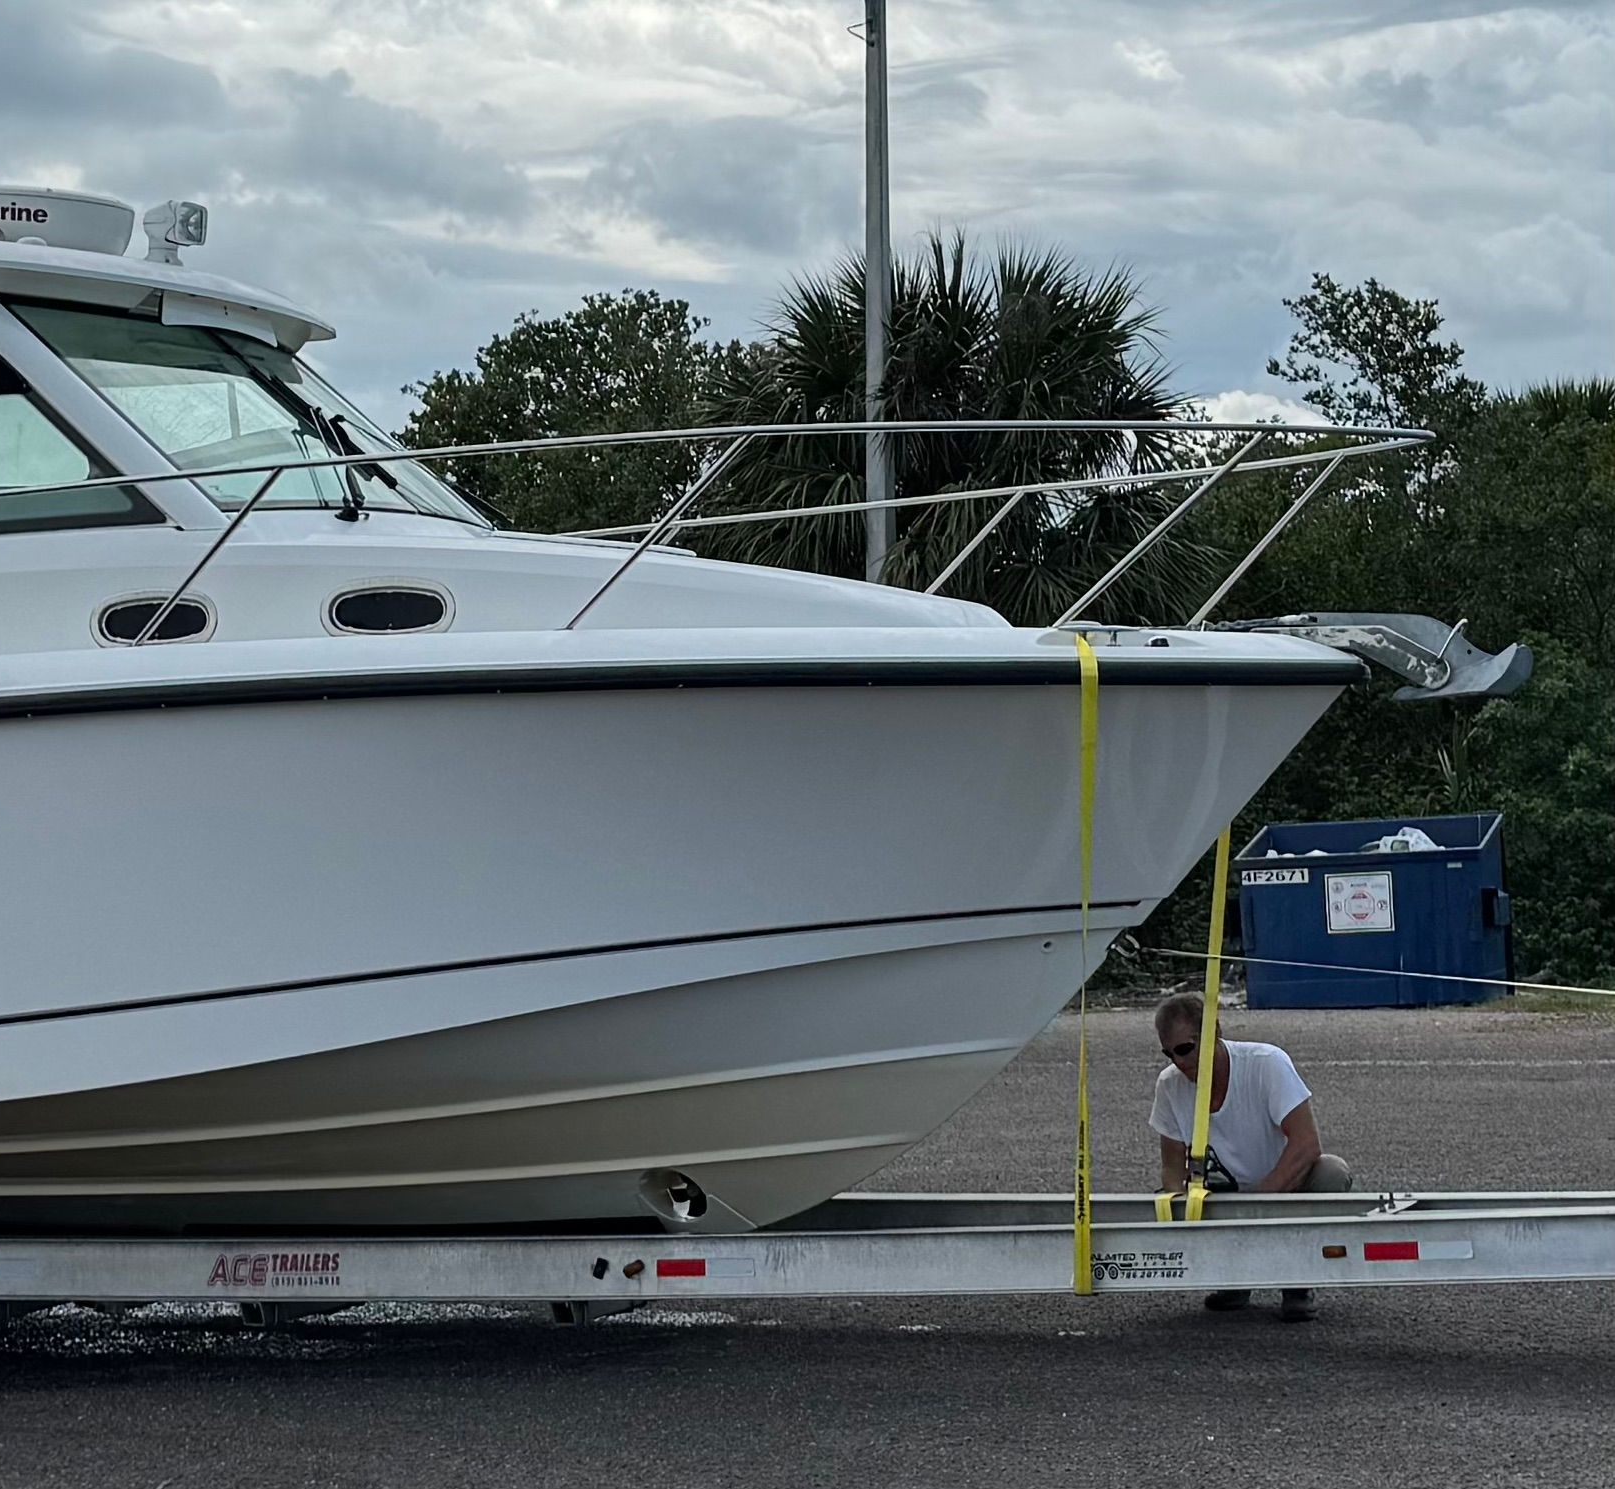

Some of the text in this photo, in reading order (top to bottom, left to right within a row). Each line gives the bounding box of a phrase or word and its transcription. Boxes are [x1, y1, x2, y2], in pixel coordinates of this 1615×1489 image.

[1243, 869, 1306, 882] 4F2671
[207, 1253, 340, 1287] ACE TRAILERS
